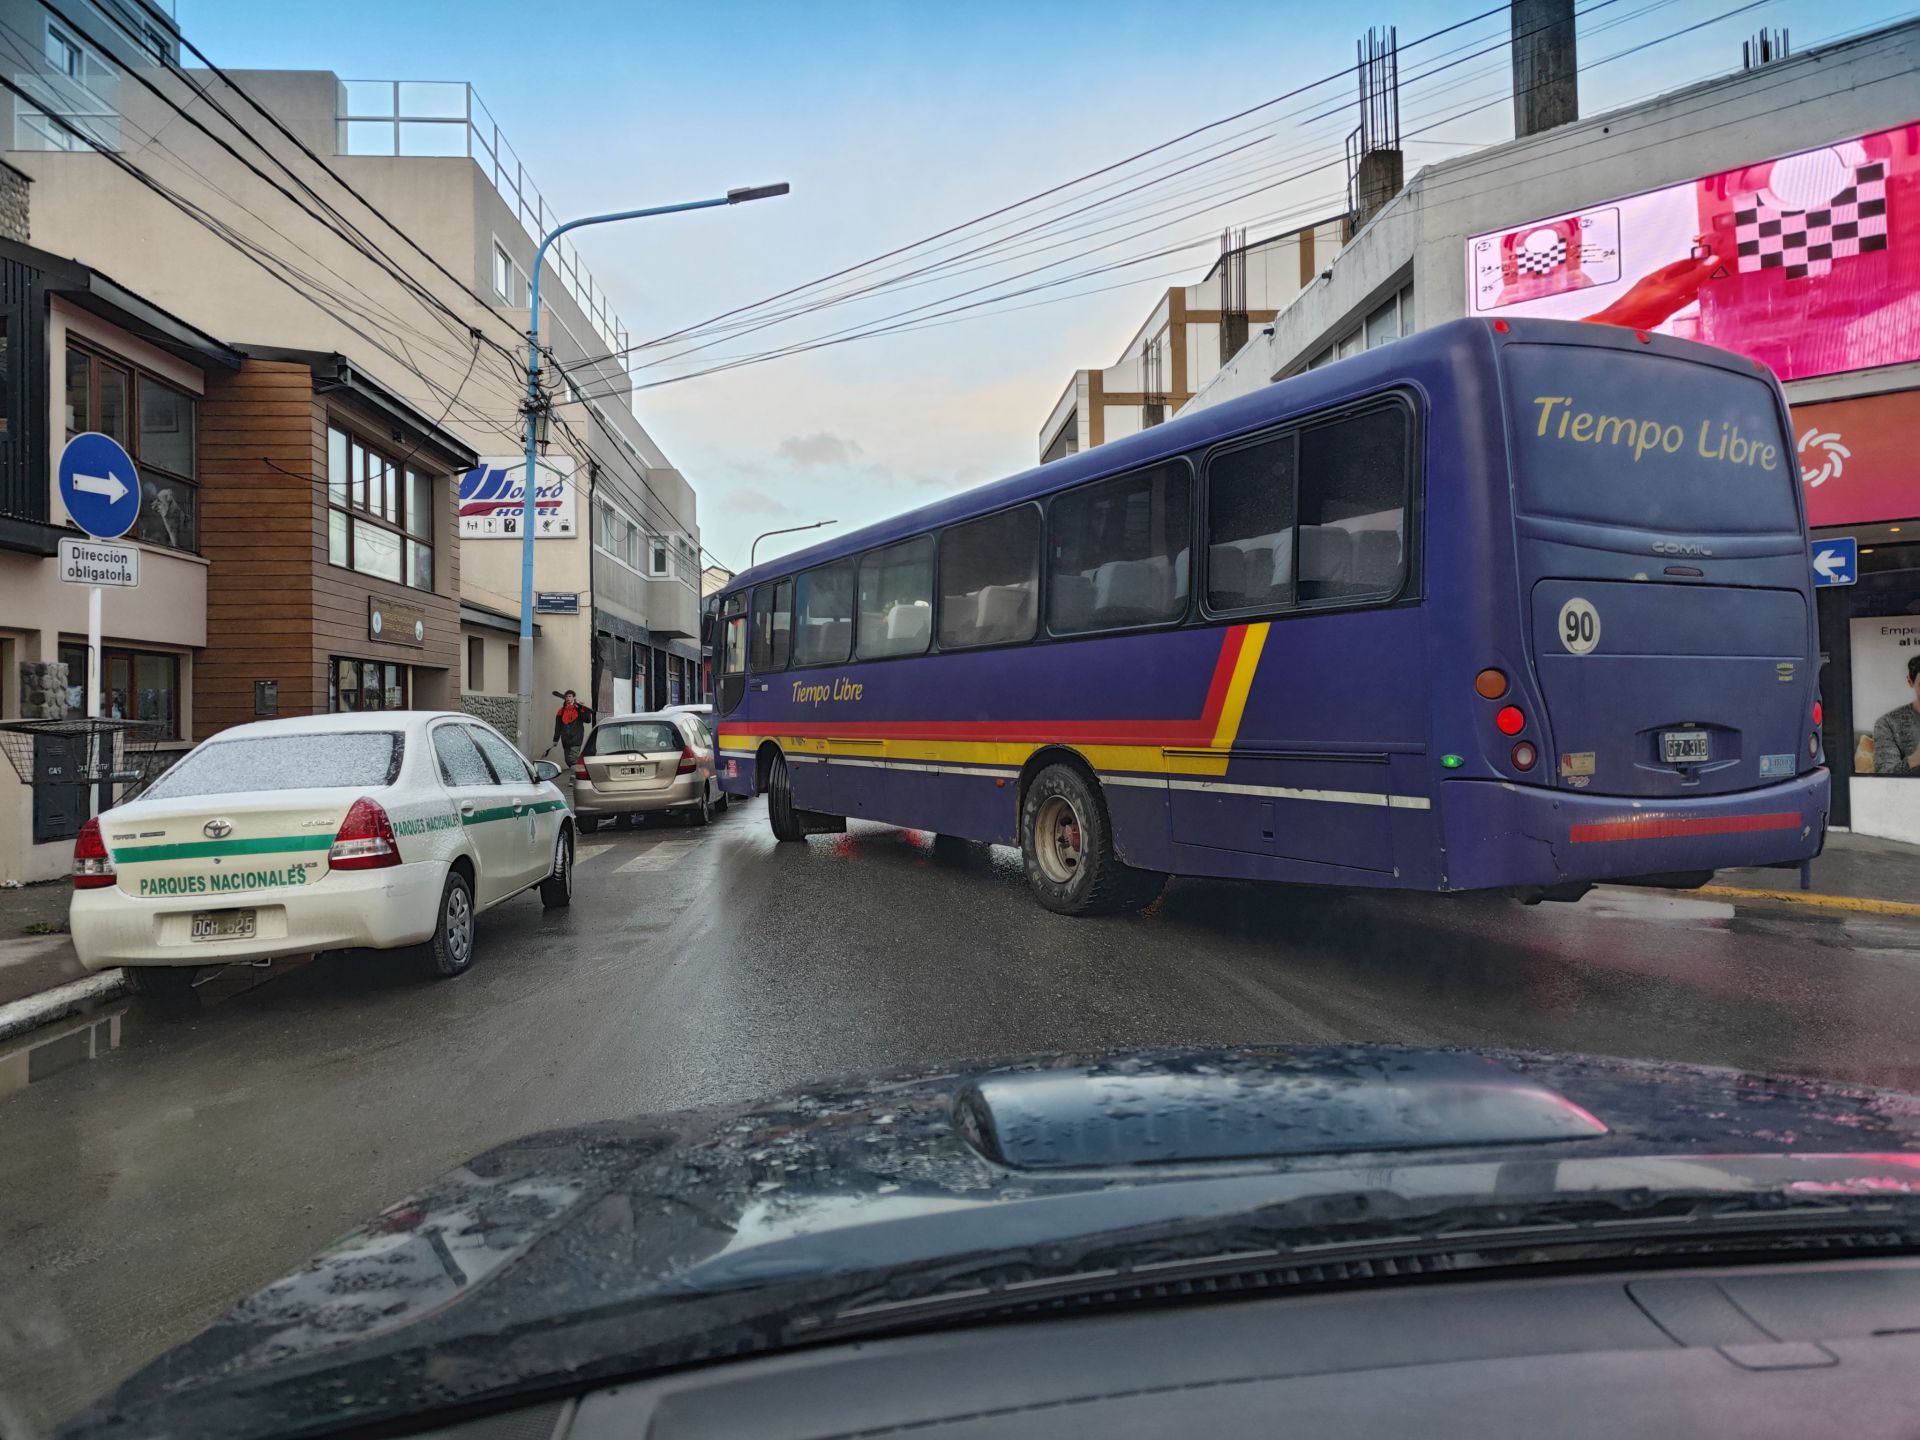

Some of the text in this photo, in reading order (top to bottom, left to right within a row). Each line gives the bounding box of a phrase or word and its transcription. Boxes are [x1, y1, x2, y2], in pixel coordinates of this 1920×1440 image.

[1534, 397, 1777, 471] Tiempo Libre
[496, 508, 560, 517] HOEL
[72, 546, 128, 564] Dirección
[67, 560, 132, 582] obligatoria
[1566, 611, 1594, 642] 90
[792, 677, 863, 708] Tiempo Libre
[393, 812, 460, 837] PARQUES NACIONALES
[140, 868, 307, 896] PARQUES NACIONALES
